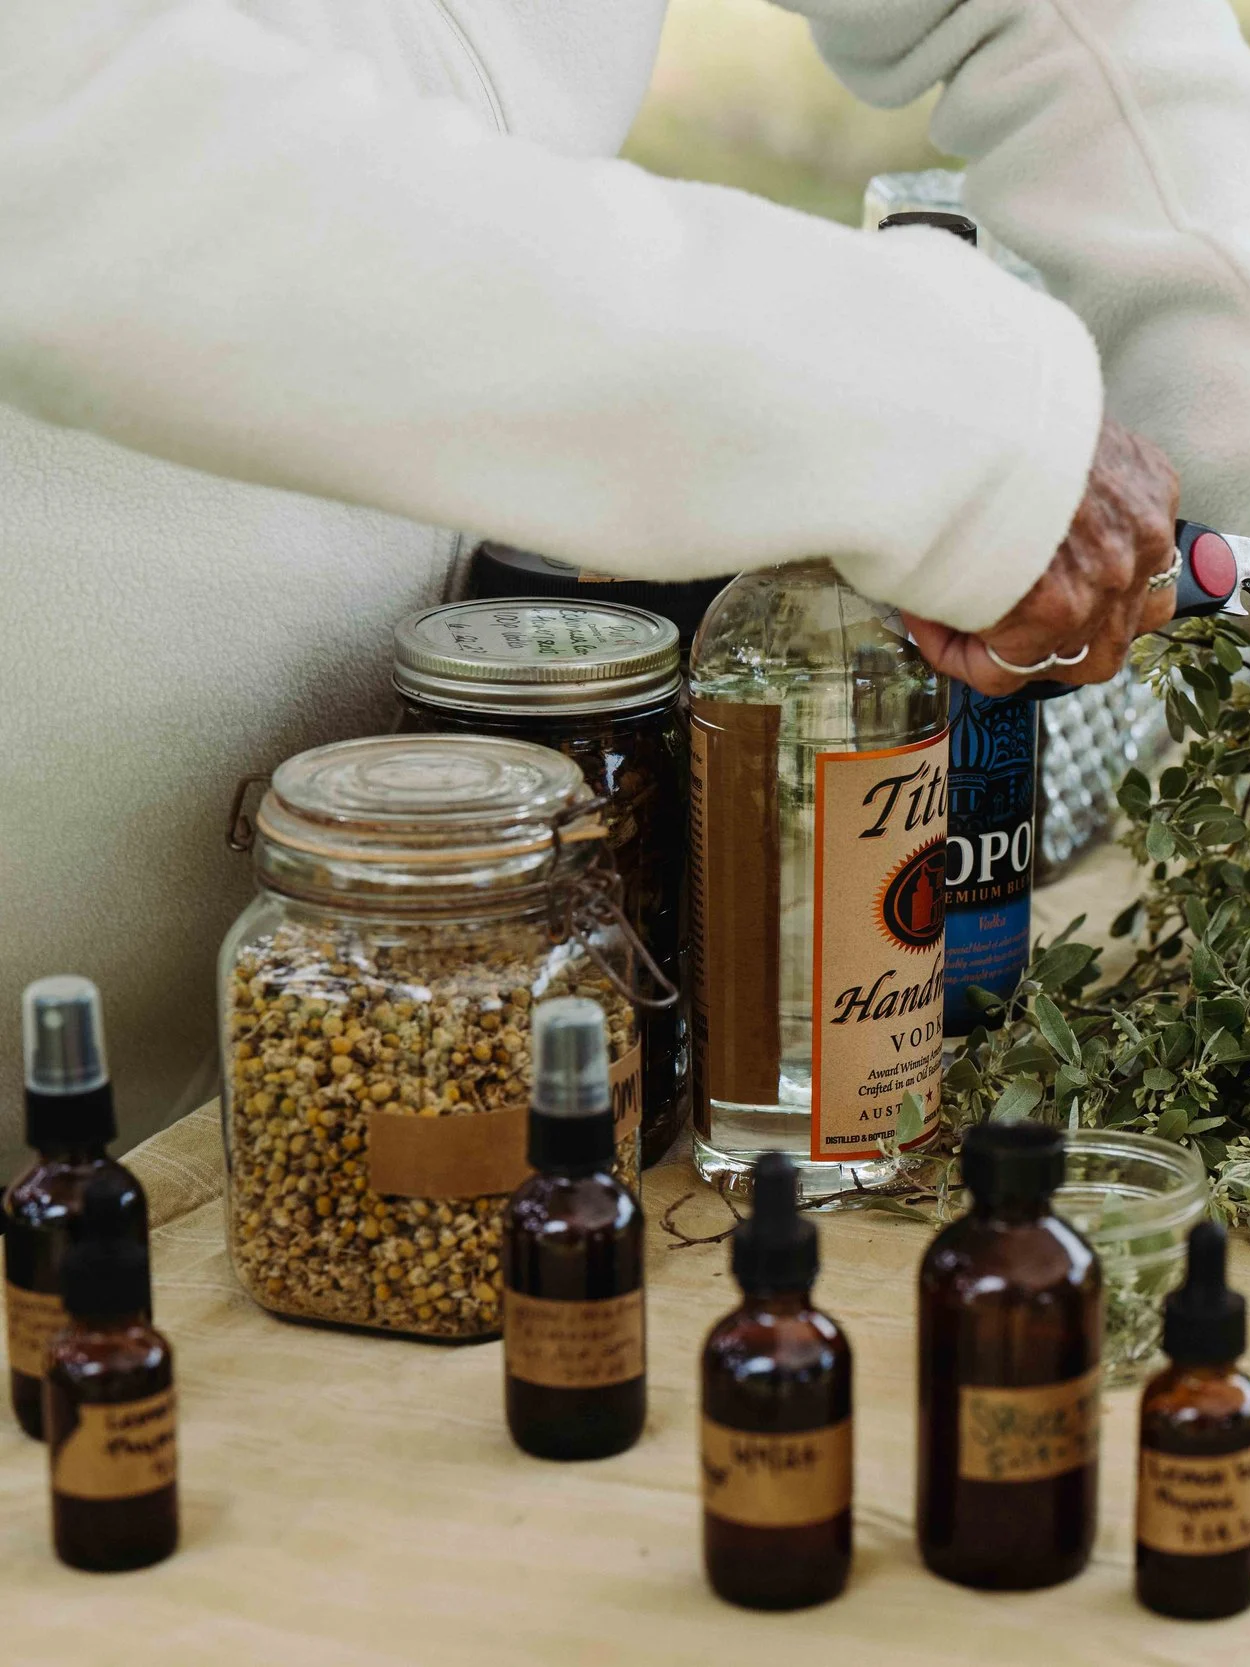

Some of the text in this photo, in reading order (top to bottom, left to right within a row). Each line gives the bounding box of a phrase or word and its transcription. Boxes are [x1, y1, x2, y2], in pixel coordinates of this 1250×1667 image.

[979, 912, 1007, 931] Vodka
[867, 1063, 900, 1081] Award
[900, 1055, 930, 1074] Winning
[858, 1079, 893, 1099] Crafted
[895, 1079, 904, 1091] in
[906, 1077, 915, 1087] an
[917, 1064, 928, 1083] Old
[825, 1129, 896, 1145] DISTILLED & BOTTLED
